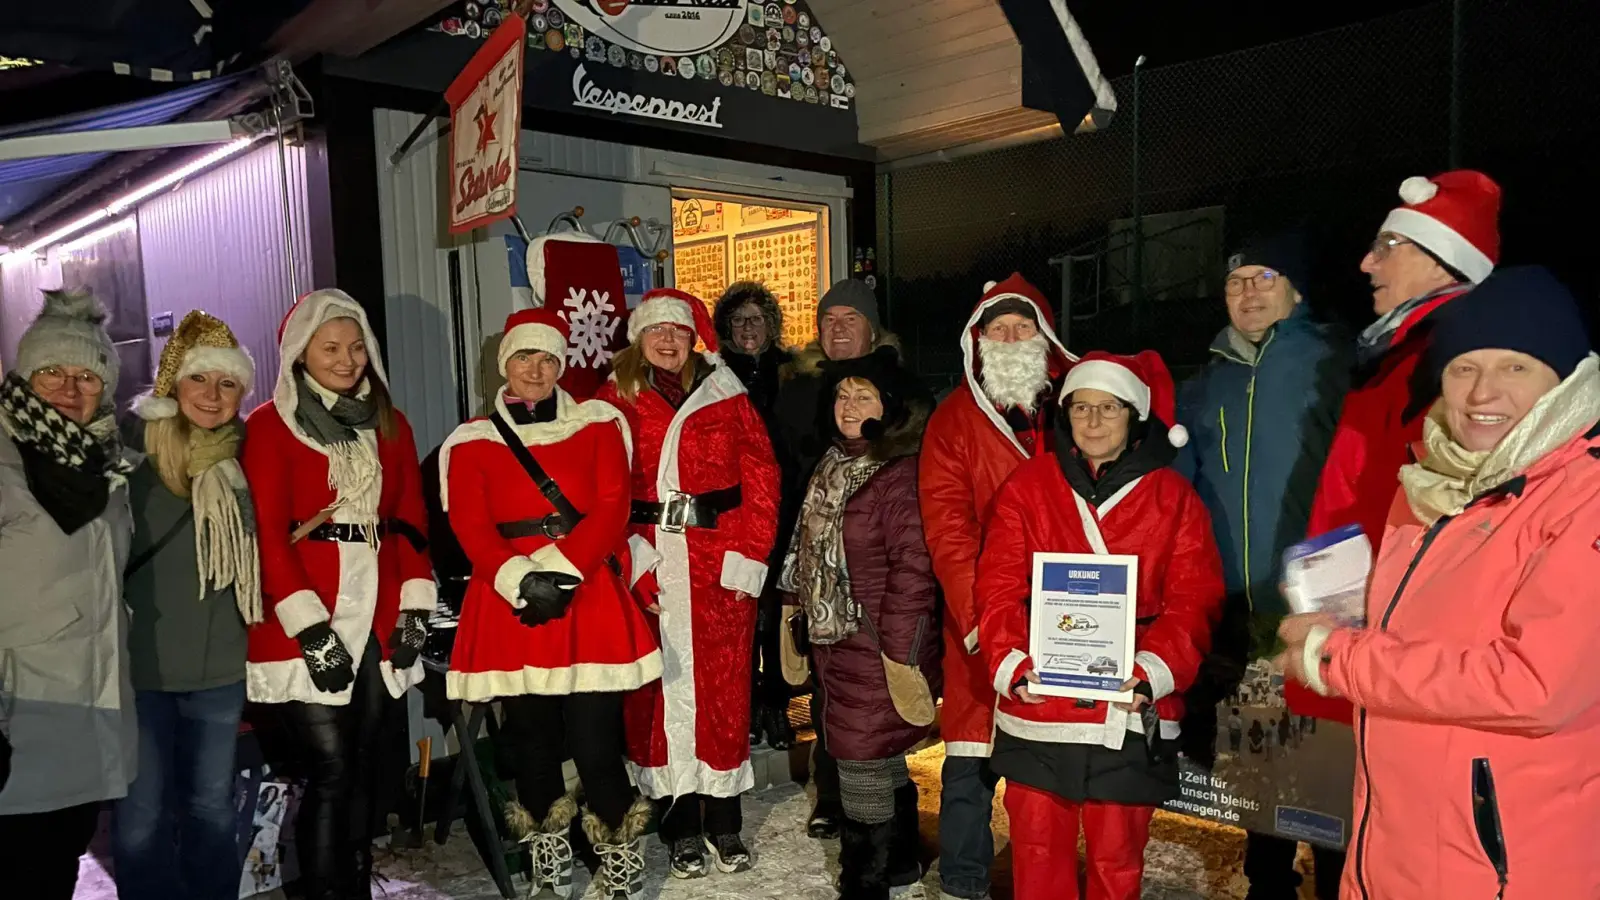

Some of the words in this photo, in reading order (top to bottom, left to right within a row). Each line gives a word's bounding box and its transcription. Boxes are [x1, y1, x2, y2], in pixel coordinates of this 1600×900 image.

[681, 10, 701, 20] 2016
[572, 62, 723, 128] Vespennest
[1068, 569, 1100, 580] URKUNDE
[1184, 771, 1208, 786] Zeit
[1210, 776, 1228, 789] für
[1180, 784, 1218, 802] unsch
